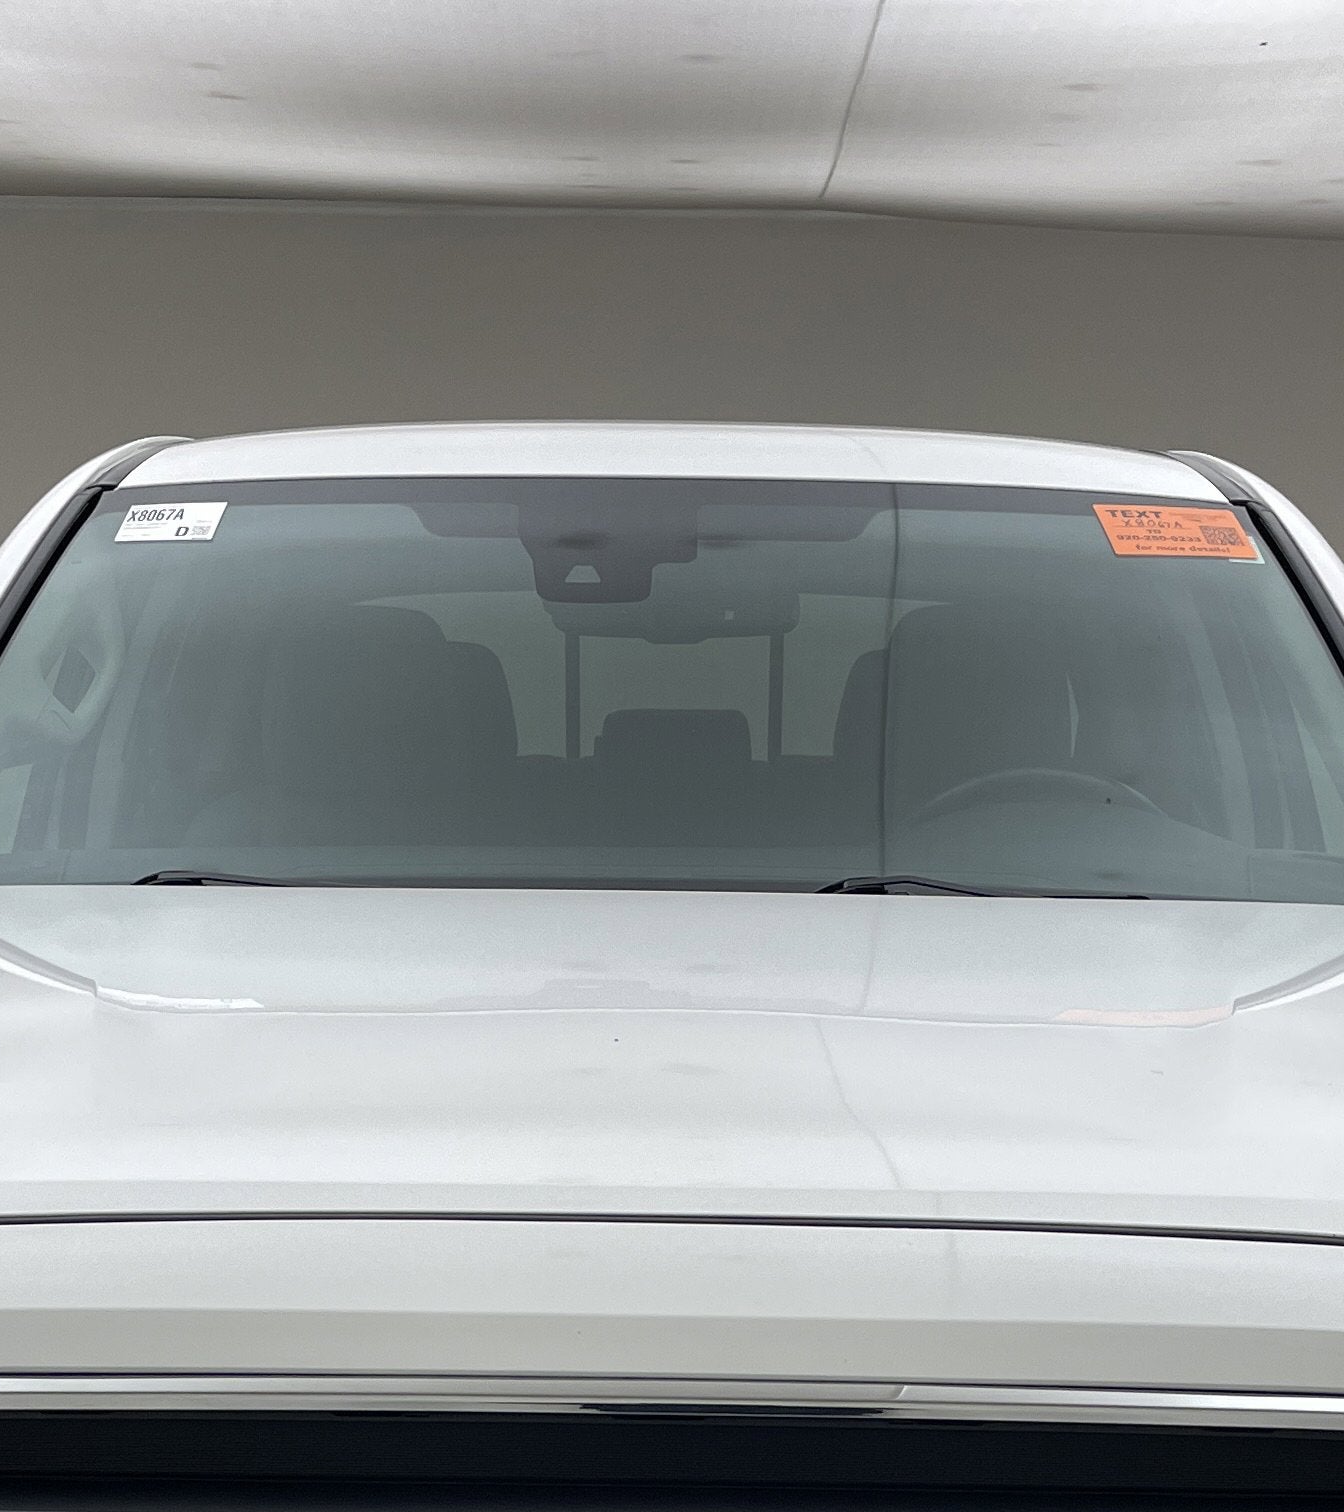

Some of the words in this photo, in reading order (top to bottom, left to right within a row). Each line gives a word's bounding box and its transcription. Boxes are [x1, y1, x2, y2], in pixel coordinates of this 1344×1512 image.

[127, 508, 184, 522] X8067A
[1106, 510, 1162, 518] TEXT
[175, 526, 189, 536] D
